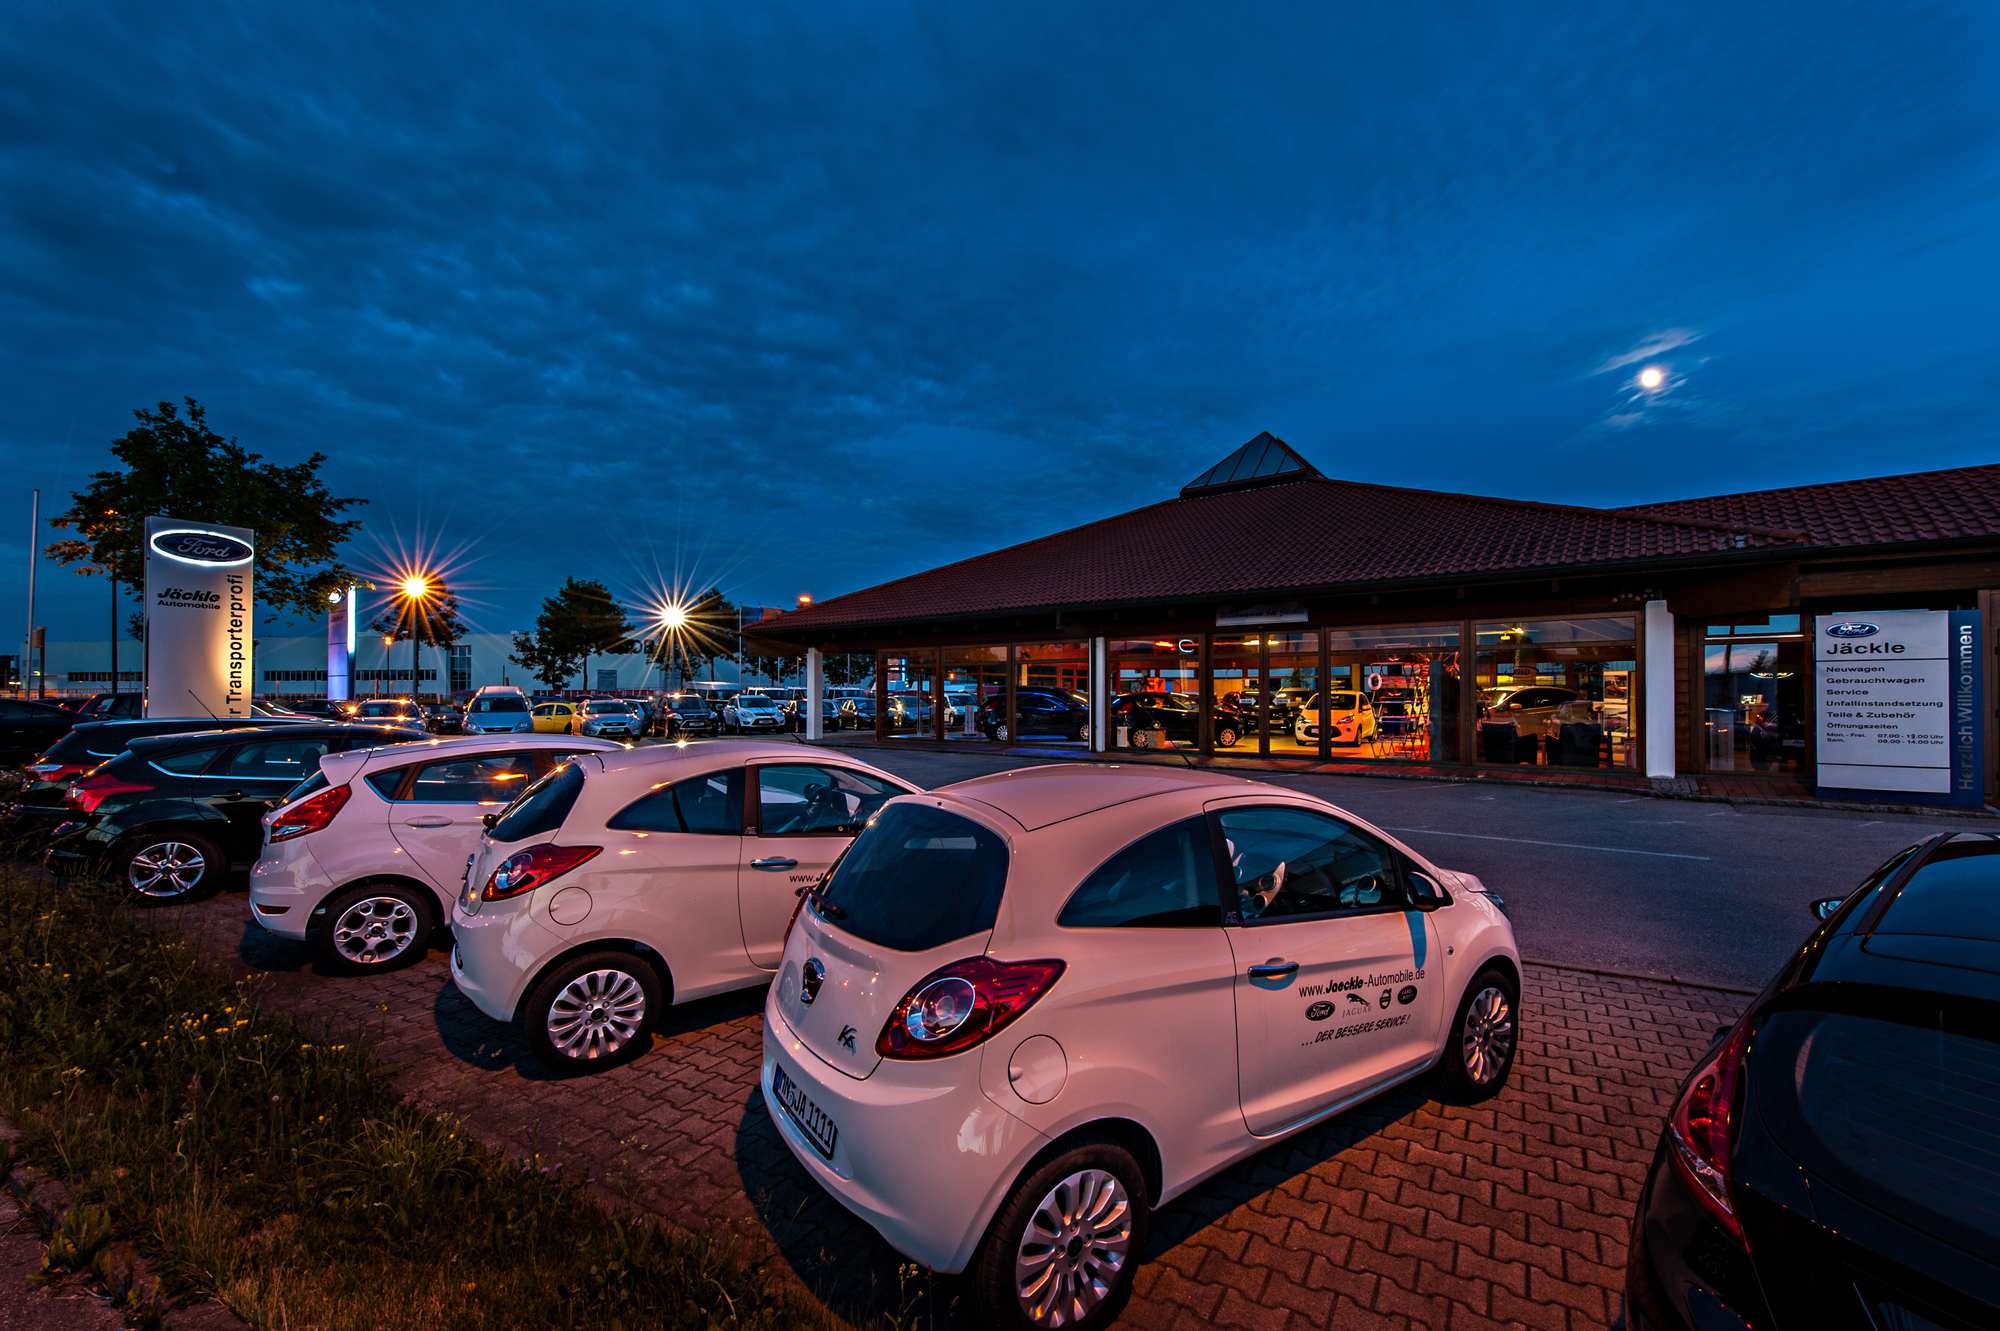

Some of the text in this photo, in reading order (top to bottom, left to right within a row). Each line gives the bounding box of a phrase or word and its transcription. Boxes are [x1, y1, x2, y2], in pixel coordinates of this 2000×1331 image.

[177, 537, 230, 558] Ford
[157, 587, 221, 602] Jäckle
[157, 600, 221, 610] Automobile
[1219, 611, 1264, 619] Willkommen
[1836, 623, 1869, 636] Ford
[226, 574, 247, 705] Transporterprofi
[1826, 642, 1906, 655] Jäckle
[1826, 666, 1885, 674] Neuwagen
[1826, 677, 1925, 685] Gebrauchtwagen
[1826, 700, 1944, 708] Unfallinstandsetzung
[1956, 625, 1974, 790] Herzlich Willkommen
[1866, 711, 1916, 719] Zubehör
[1826, 722, 1898, 730] Öffnungszeiten
[1298, 967, 1425, 998] www.Jaeckle-Automobile.de
[1342, 1005, 1372, 1019] JAGUAR
[1315, 1029, 1335, 1044] DER
[1335, 1021, 1375, 1040] BESSERE
